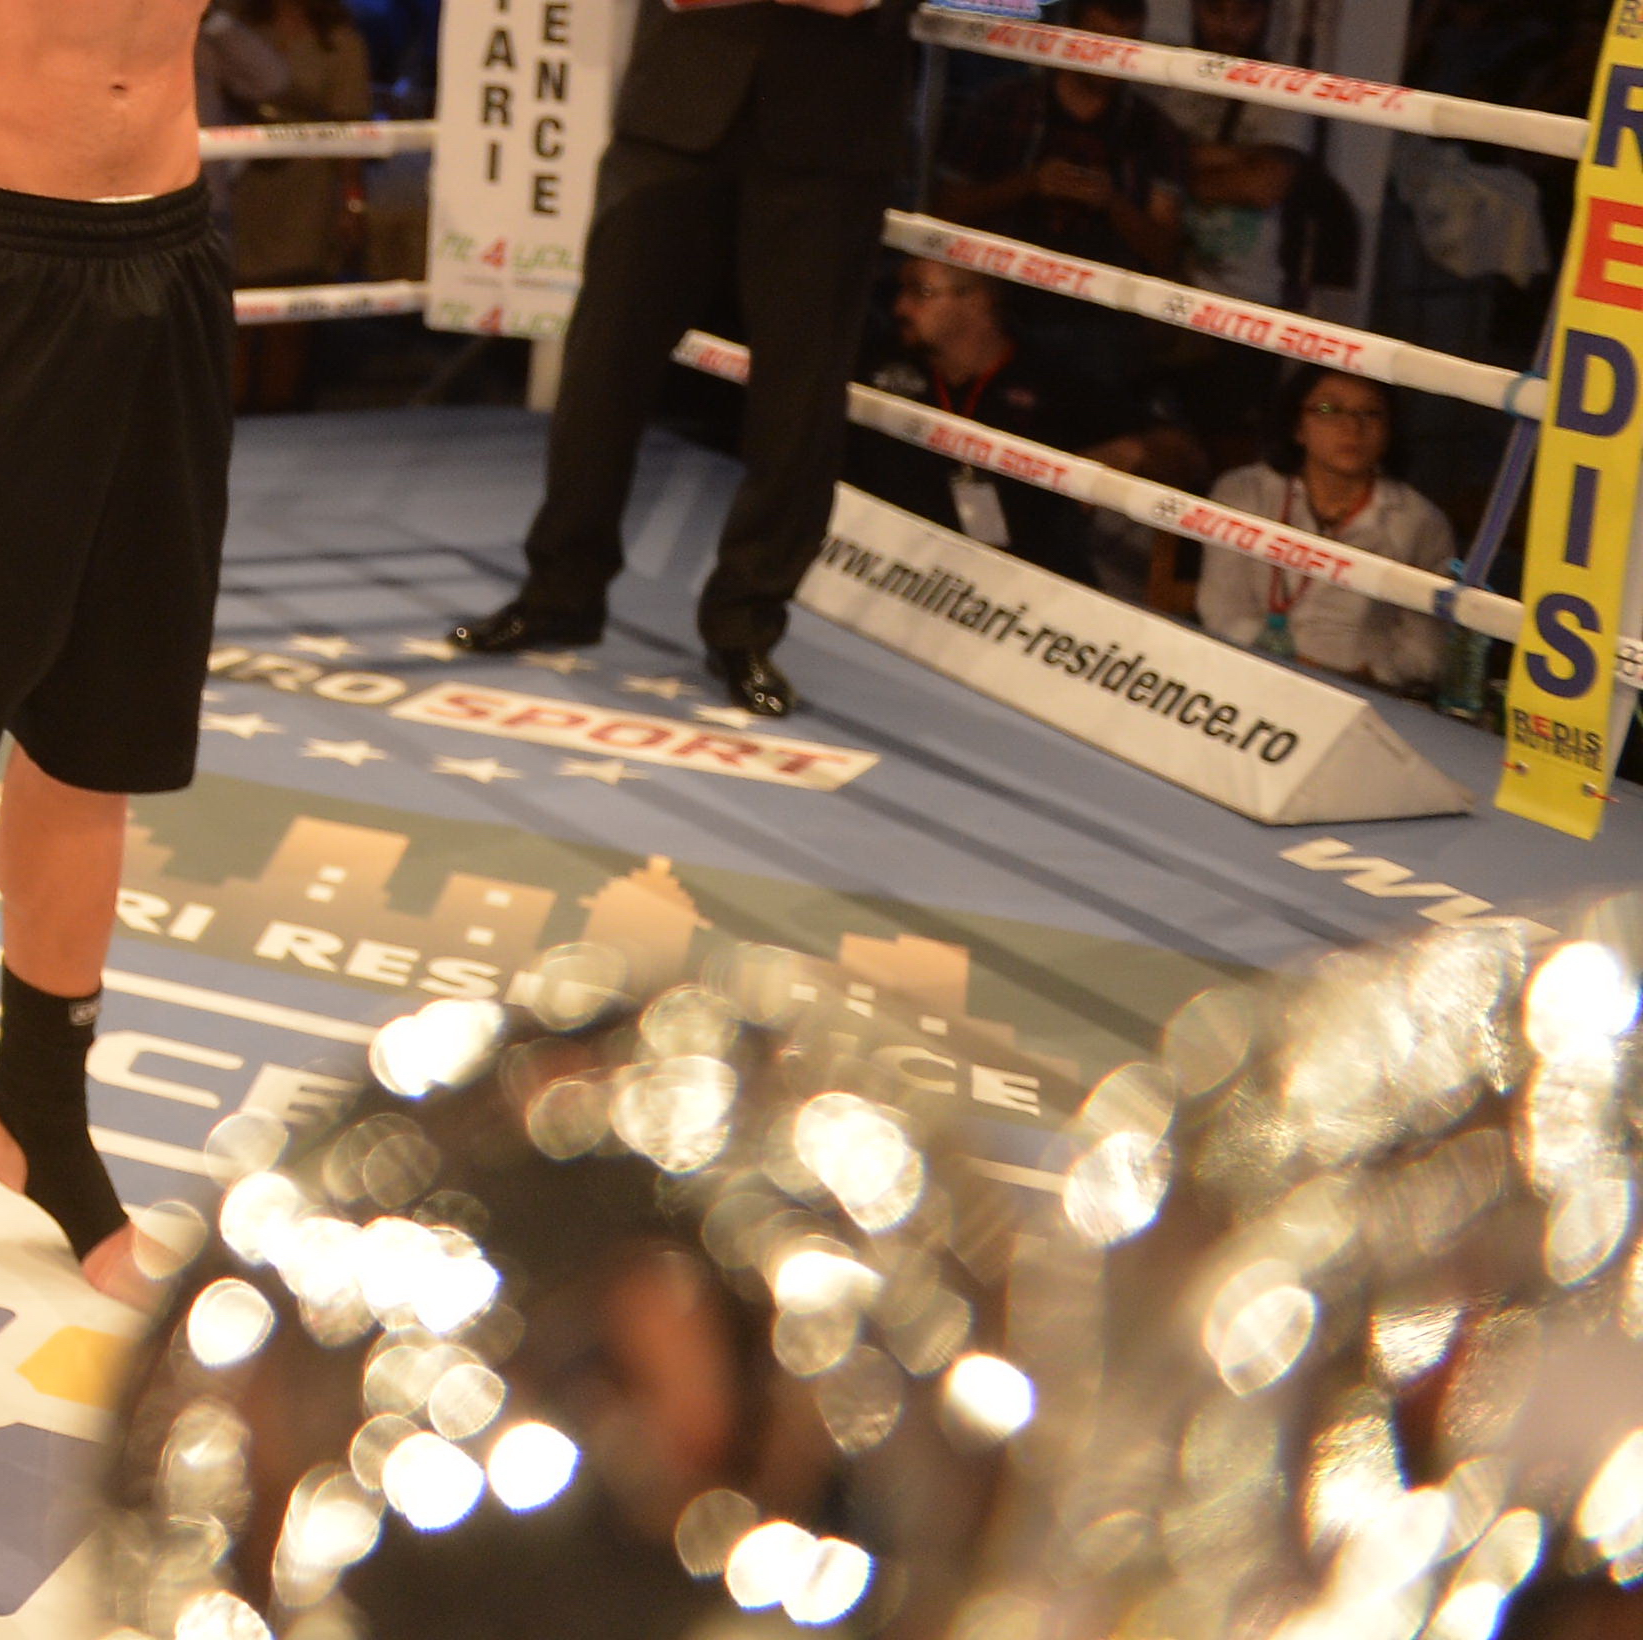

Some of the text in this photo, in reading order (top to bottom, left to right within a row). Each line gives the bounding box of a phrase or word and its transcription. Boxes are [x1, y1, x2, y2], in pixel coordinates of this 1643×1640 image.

[482, 236, 507, 268] 4
[1190, 305, 1272, 345] AUTO
[1180, 507, 1264, 550] AUTO
